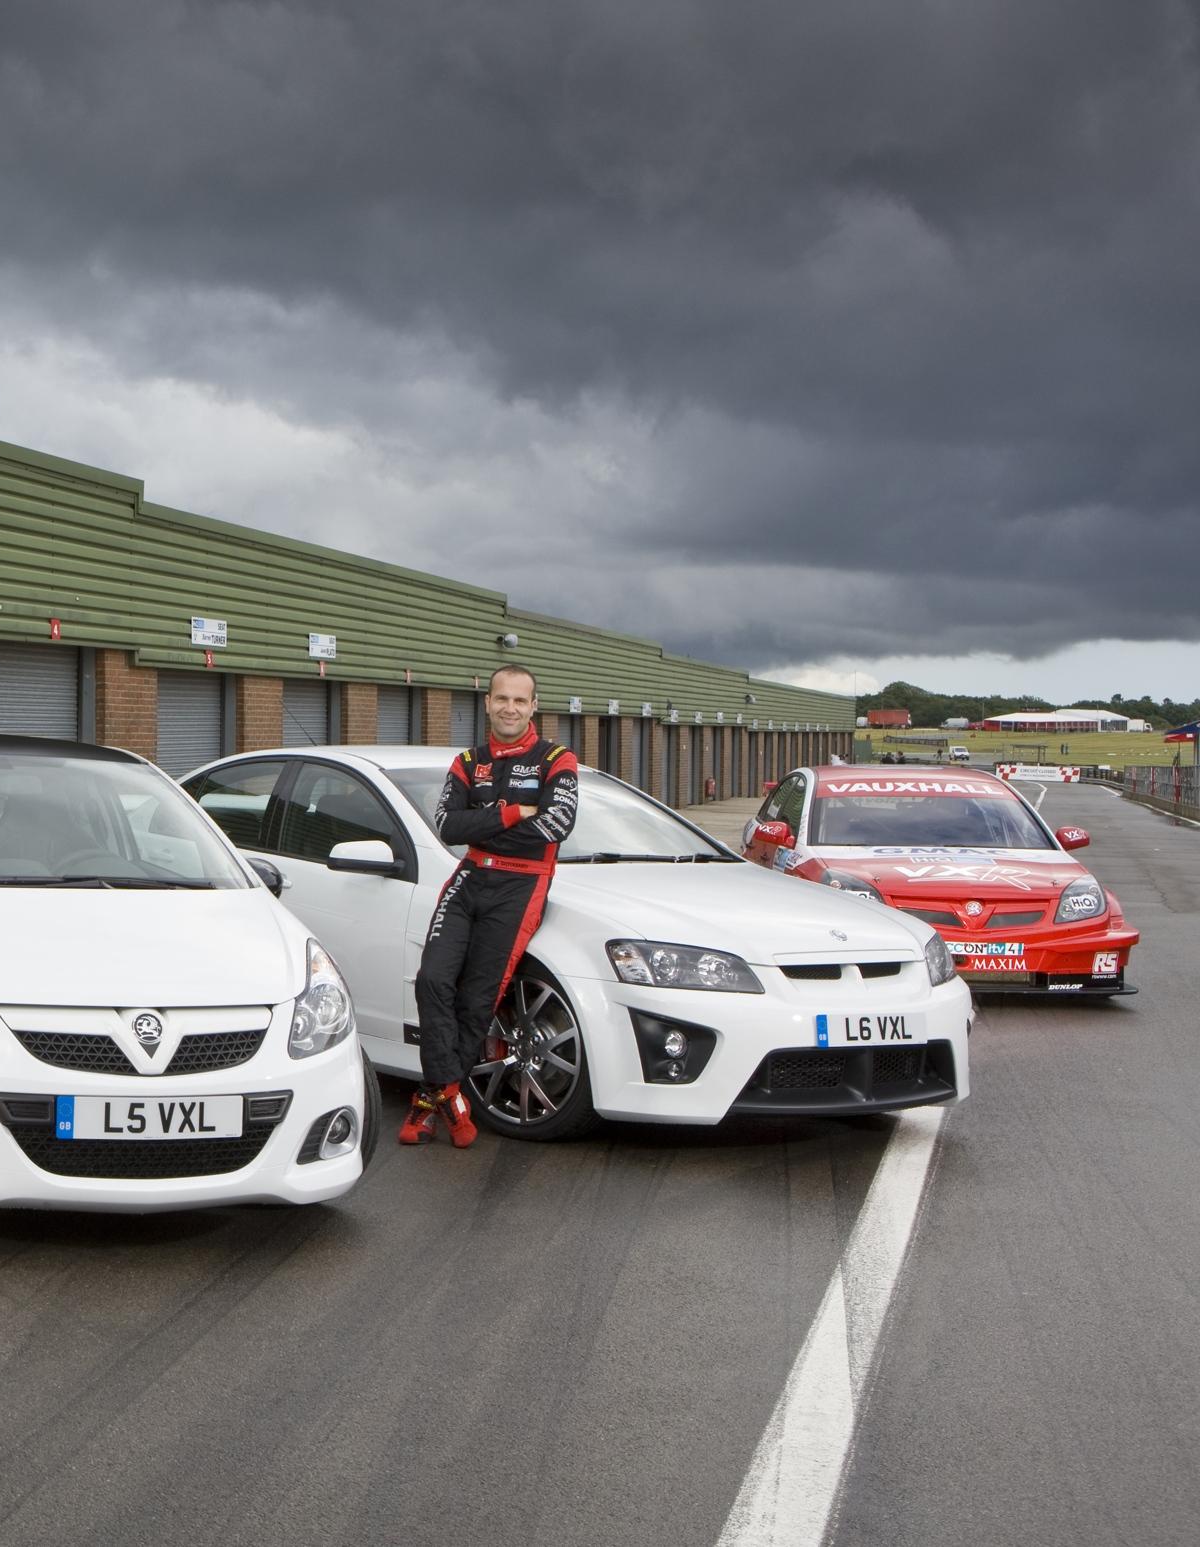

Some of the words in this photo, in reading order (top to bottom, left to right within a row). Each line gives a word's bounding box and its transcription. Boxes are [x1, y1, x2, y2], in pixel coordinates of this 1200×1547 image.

[53, 624, 58, 636] 4
[827, 782, 1004, 795] VAUXHALL
[893, 866, 1031, 891] VXR
[428, 869, 471, 942] VAUXHALL
[1071, 898, 1093, 907] HiQ
[974, 958, 1027, 970] MAXIM
[1094, 953, 1118, 973] RS
[845, 1017, 872, 1041] L6
[877, 1016, 912, 1040] VXL
[59, 1121, 71, 1130] GB
[104, 1102, 146, 1133] L5
[158, 1102, 216, 1133] VXL
